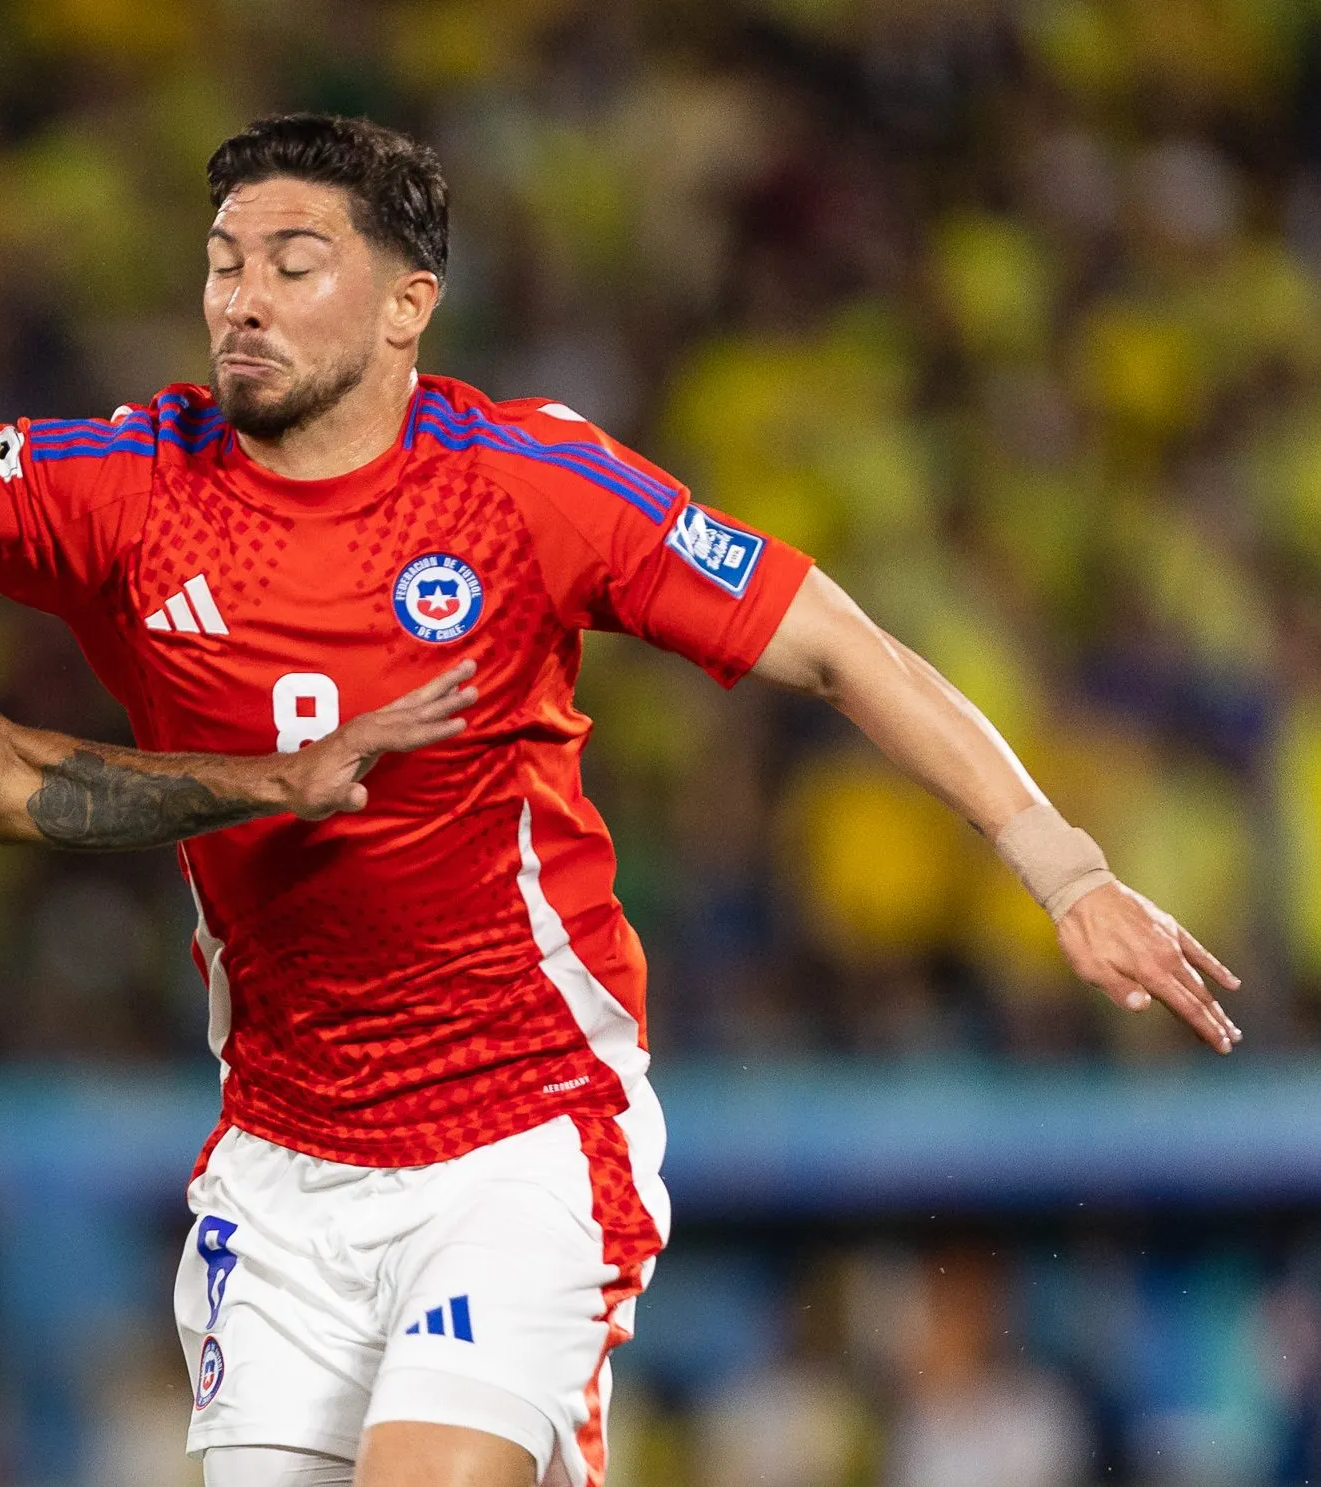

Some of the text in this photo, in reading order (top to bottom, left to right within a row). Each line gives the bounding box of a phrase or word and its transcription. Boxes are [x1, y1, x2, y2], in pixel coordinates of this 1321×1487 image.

[443, 557, 458, 569] DE
[458, 565, 482, 598] FUTBOL
[417, 624, 463, 640] DE CHILE
[272, 672, 339, 753] 8
